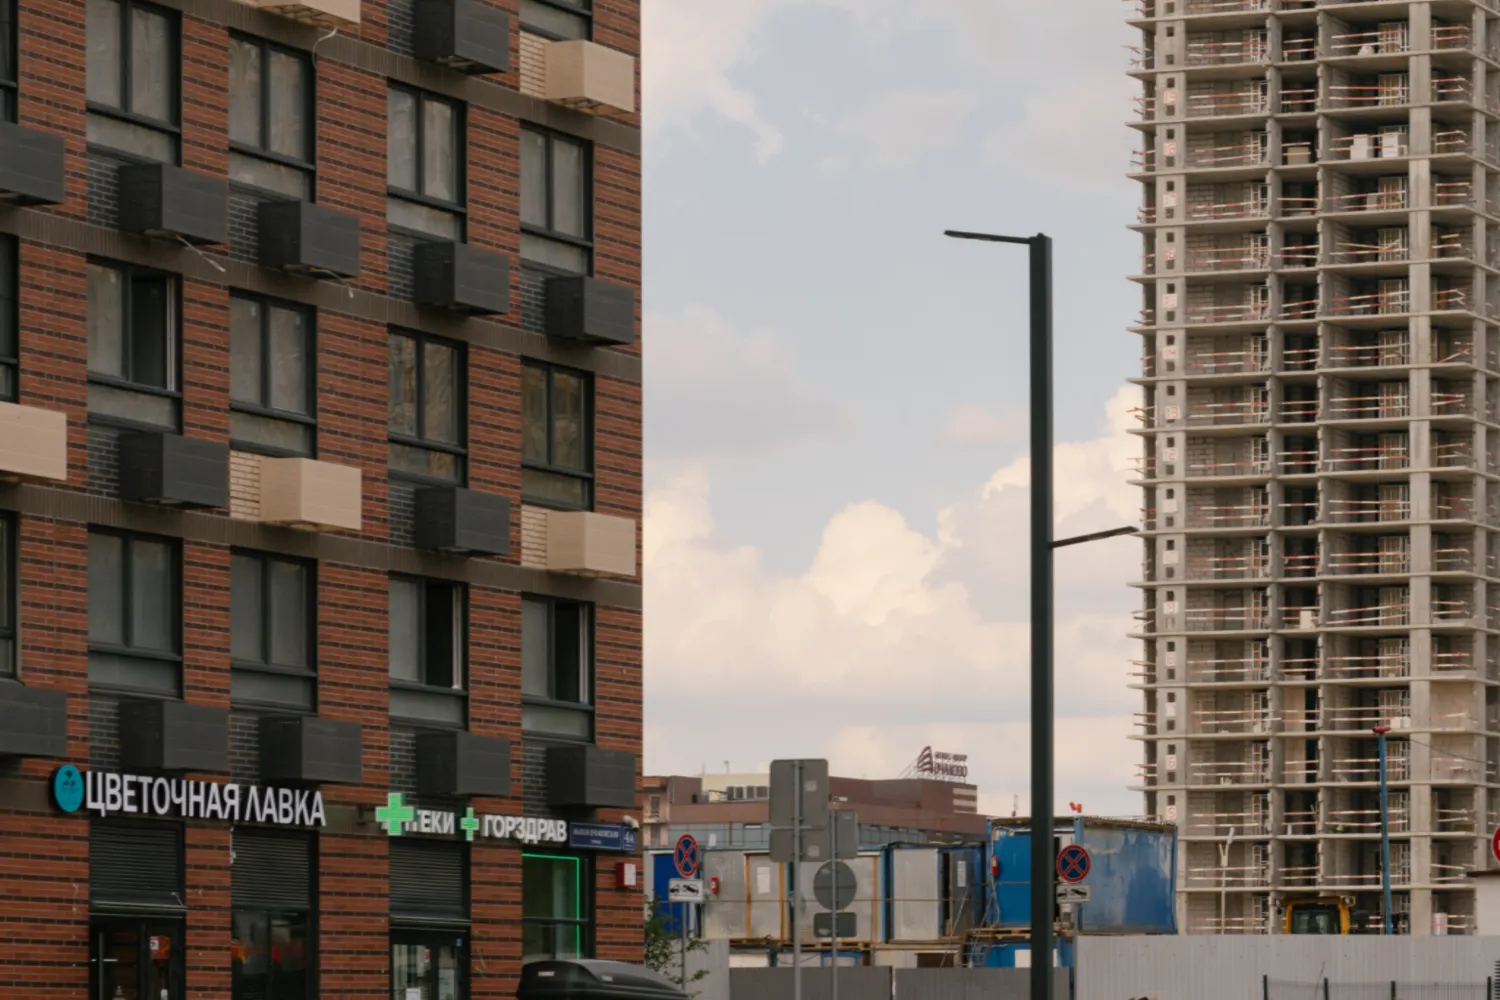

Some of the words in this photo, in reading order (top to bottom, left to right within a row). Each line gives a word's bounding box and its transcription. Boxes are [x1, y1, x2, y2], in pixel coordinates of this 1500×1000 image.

[86, 770, 240, 821] ЦВЕТОЧНАЯ
[244, 785, 327, 827] ЛАВКА
[483, 813, 568, 844] ГОРЗДРАВ
